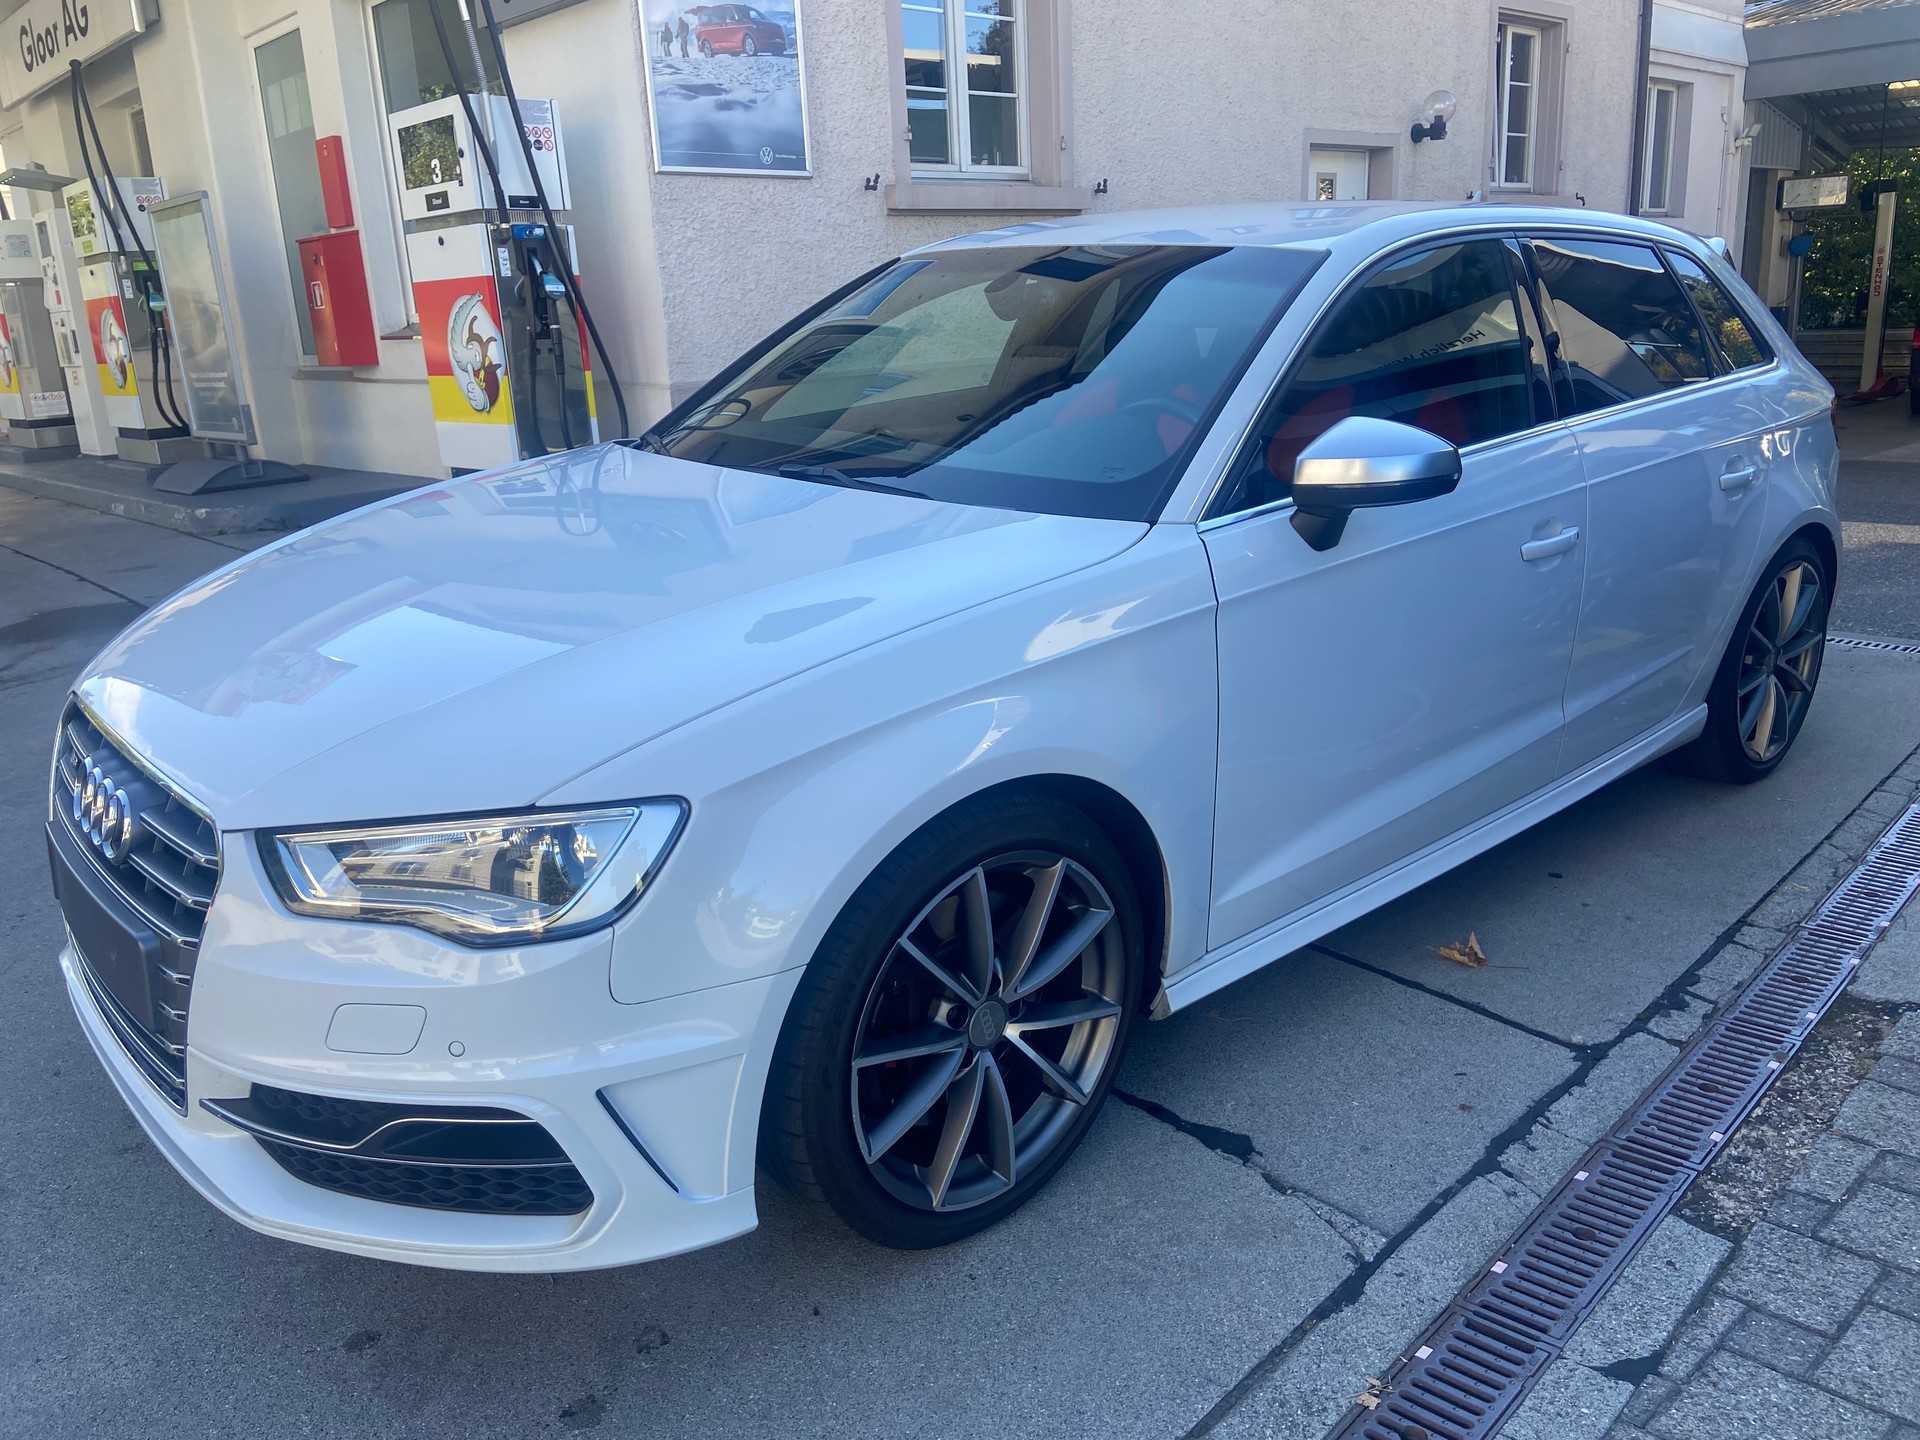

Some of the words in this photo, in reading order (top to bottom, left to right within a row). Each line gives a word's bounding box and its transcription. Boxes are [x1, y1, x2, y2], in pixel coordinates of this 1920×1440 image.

[20, 18, 60, 72] Gloor
[62, 0, 89, 47] AG
[430, 158, 443, 184] 3
